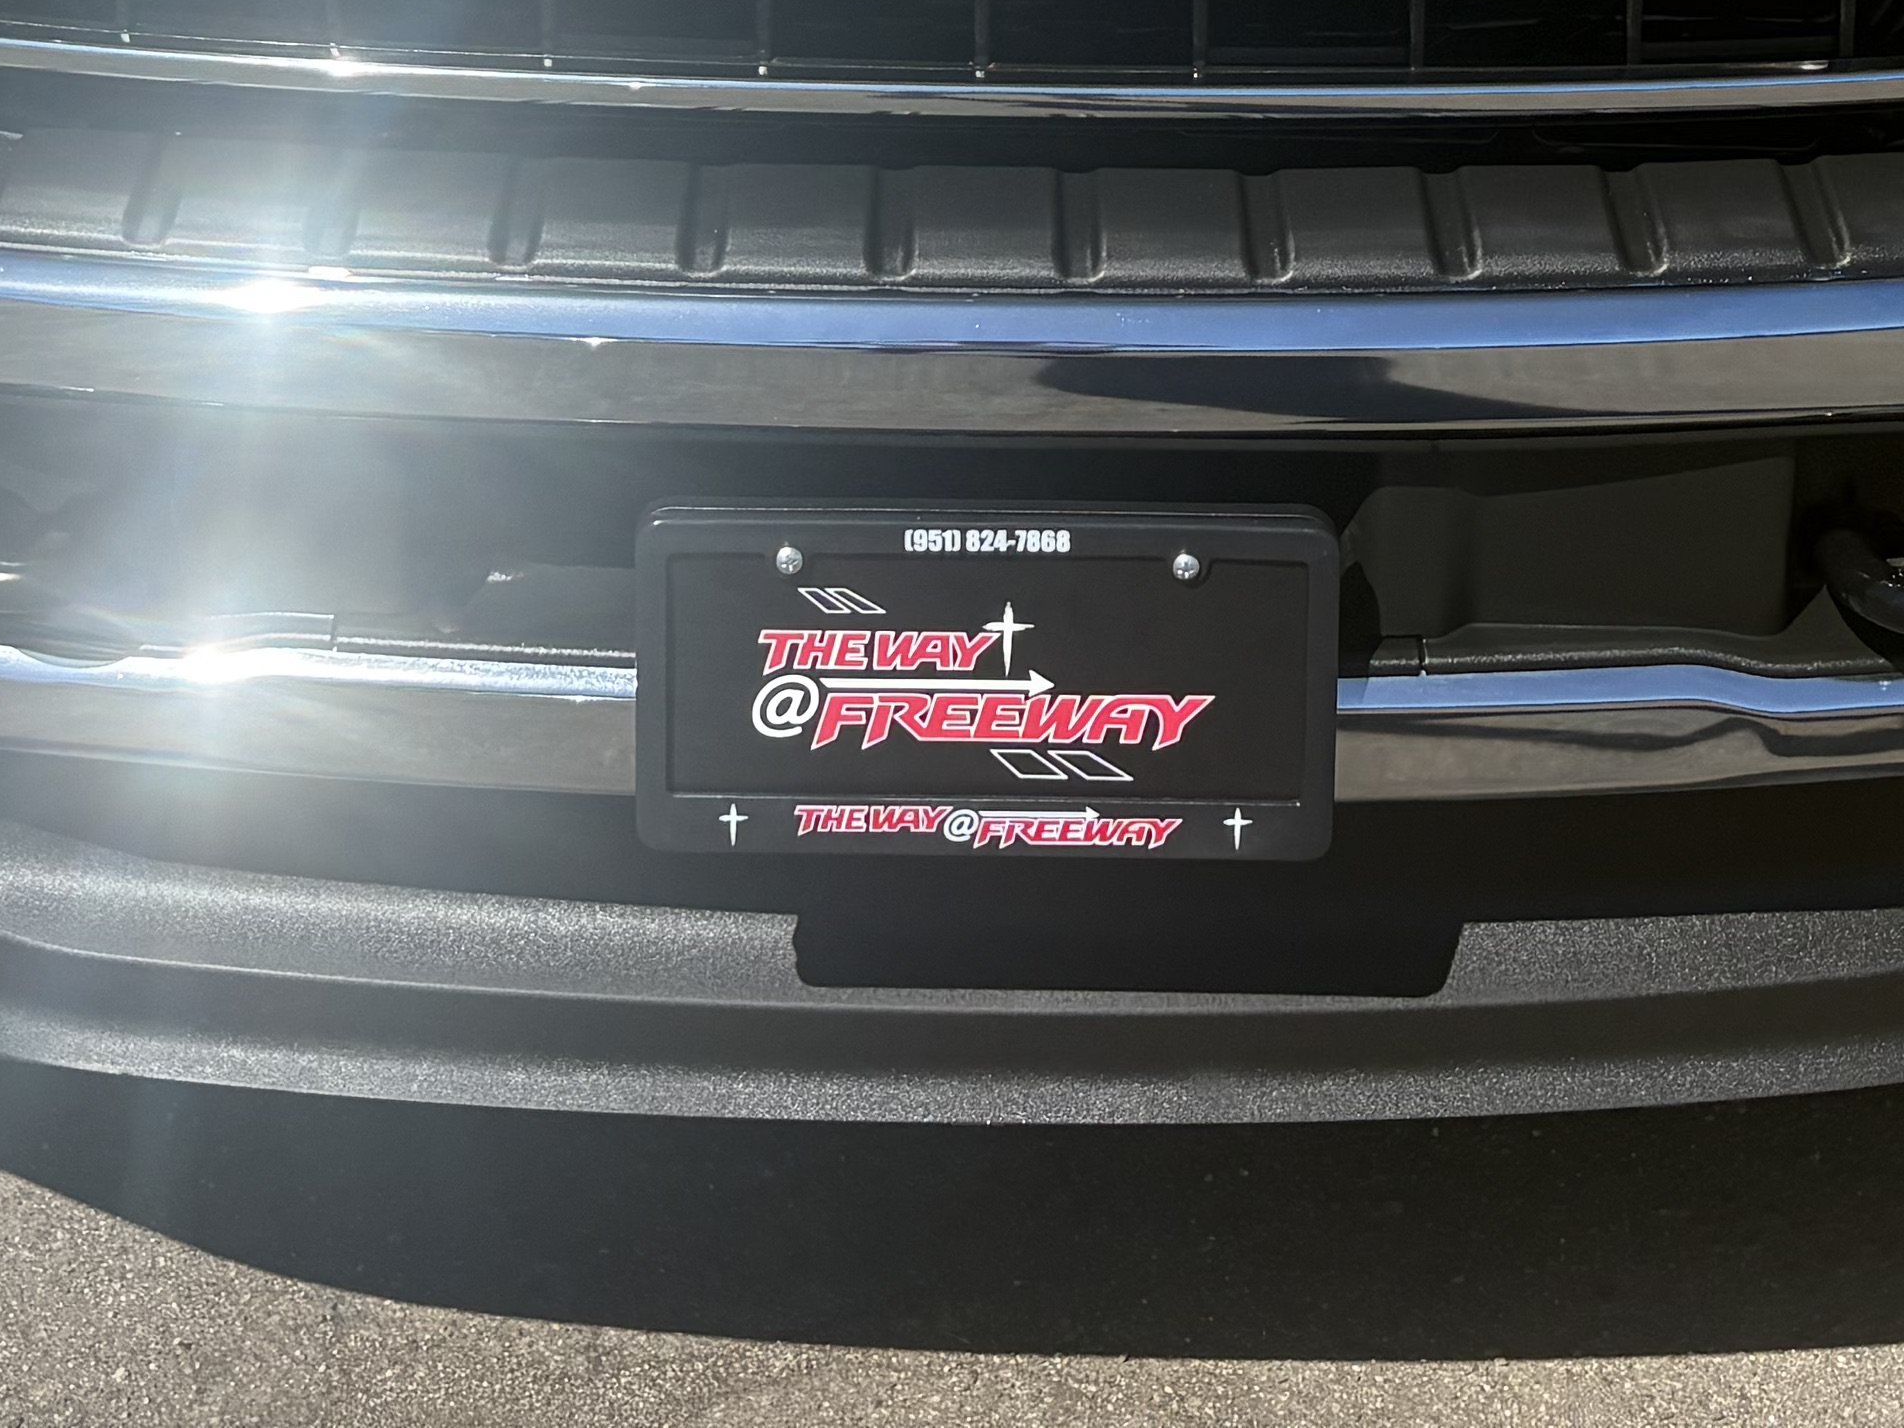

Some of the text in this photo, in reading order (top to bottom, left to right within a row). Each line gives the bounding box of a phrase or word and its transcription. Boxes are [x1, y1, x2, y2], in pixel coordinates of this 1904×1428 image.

[904, 529, 1071, 554] (951) 824-7868
[757, 629, 1002, 675] THE WAY
